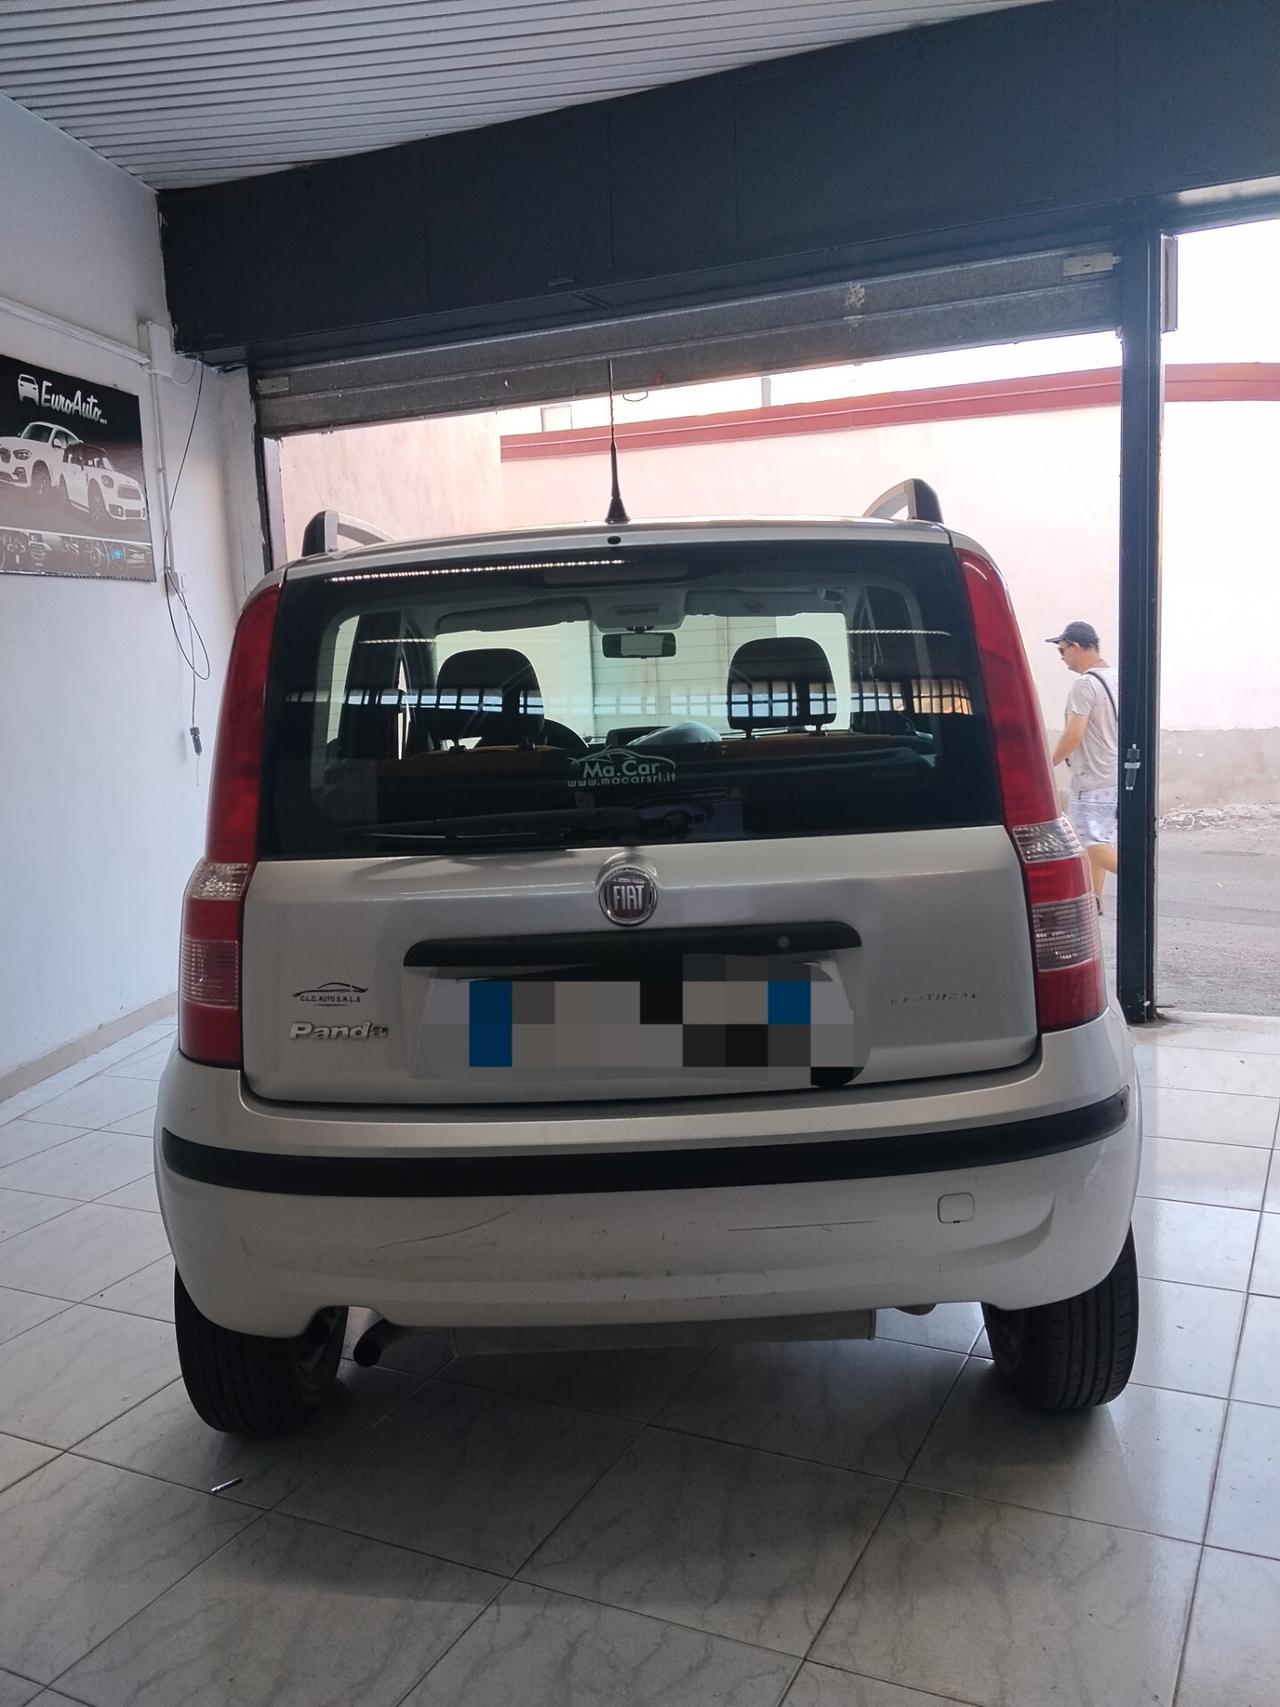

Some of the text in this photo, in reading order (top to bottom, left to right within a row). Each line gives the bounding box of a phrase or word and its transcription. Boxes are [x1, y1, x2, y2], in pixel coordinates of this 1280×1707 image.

[41, 380, 102, 421] EuroAuto
[583, 760, 660, 779] Ma.Car
[567, 772, 677, 788] www.macarsrl.it
[613, 885, 645, 911] FIAT
[318, 995, 336, 1003] AUTO
